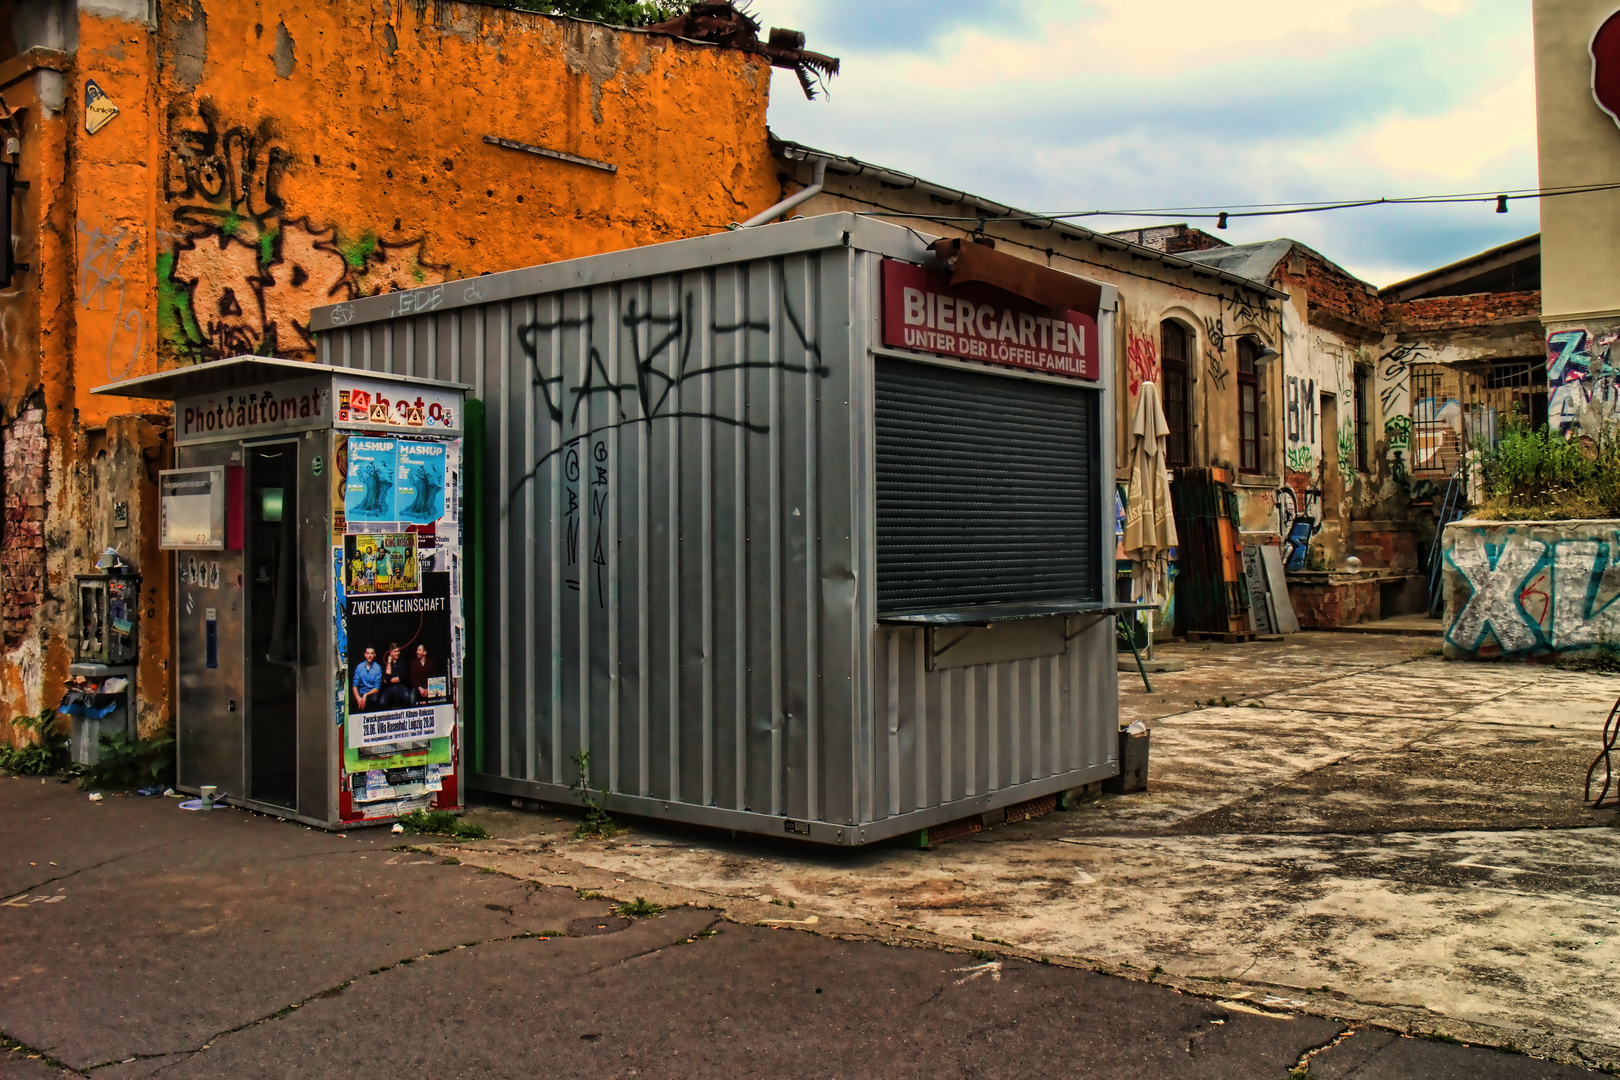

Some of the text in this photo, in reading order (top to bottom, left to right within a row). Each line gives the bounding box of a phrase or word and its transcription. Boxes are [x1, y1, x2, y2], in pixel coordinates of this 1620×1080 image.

[903, 287, 1086, 356] BIERGARTEN
[904, 328, 1086, 374] UNTER DER LÖFFELFAMILIE
[184, 387, 321, 434] Photoautomat
[354, 391, 443, 421] hoto
[350, 441, 394, 452] MASHUP
[400, 445, 443, 456] MASHUP
[384, 538, 396, 548] KING
[351, 597, 446, 616] ZWECKGEMEINSCHAFT
[408, 717, 423, 731] Leipzig
